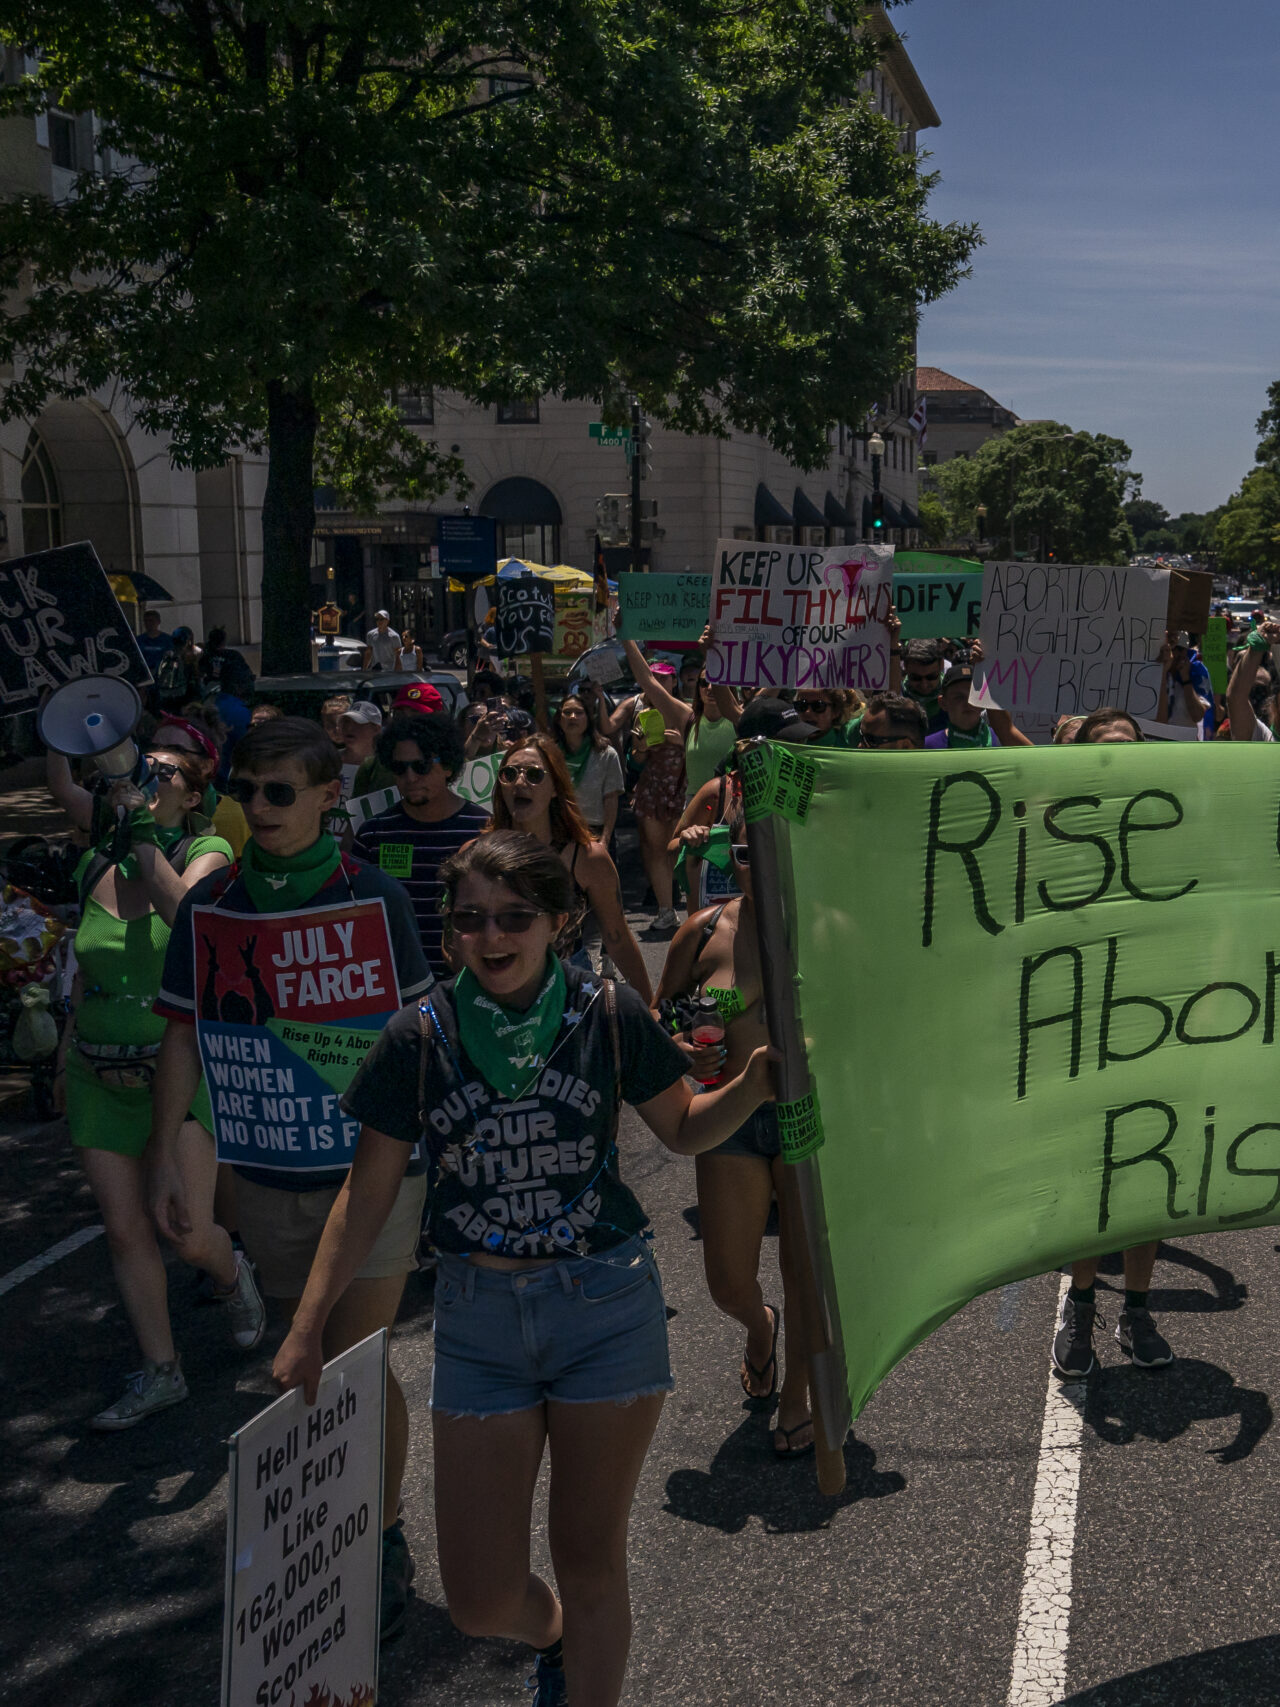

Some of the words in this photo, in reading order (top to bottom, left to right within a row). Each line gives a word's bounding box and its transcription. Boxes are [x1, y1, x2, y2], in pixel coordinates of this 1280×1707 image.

[600, 438, 620, 446] 1400
[677, 575, 712, 587] CREE
[720, 551, 782, 587] KEEP
[787, 553, 824, 586] UR
[626, 592, 650, 608] KEEP
[716, 588, 842, 626] FILTHY
[845, 582, 892, 632] LAWS
[986, 565, 1128, 613] ABORTION
[501, 626, 536, 655] US
[672, 616, 696, 629] FROM
[782, 626, 808, 647] OFF
[808, 624, 846, 645] OUR
[996, 613, 1105, 655] RIGHTS
[1106, 617, 1168, 662] ARE
[0, 627, 130, 703] LAWS
[705, 641, 797, 687] SILKY
[796, 643, 887, 689] DRAWERS
[978, 655, 1043, 705] MY
[1056, 660, 1161, 715] RIGHTS
[779, 753, 794, 783] HELL
[794, 760, 806, 788] ROE?
[773, 786, 787, 810] NO!
[797, 765, 815, 818] OVERTURN
[921, 770, 1198, 947] Rise
[272, 920, 355, 968] JULY
[275, 959, 386, 1009] FARCE
[204, 1032, 271, 1064] WHEN
[282, 1027, 310, 1044] Rise
[314, 1031, 331, 1048] Up
[334, 1035, 343, 1047] 4
[307, 1048, 349, 1068] Rights
[209, 1061, 296, 1094] WOMEN
[218, 1090, 257, 1120] ARE
[262, 1096, 313, 1123] NOT
[429, 1080, 490, 1135] OUR
[512, 1068, 600, 1117] DIES
[220, 1119, 249, 1146] NO
[257, 1124, 302, 1151] ONE
[309, 1124, 335, 1151] IS
[475, 1111, 557, 1146] OUR
[482, 1189, 561, 1226] OUR
[256, 1425, 298, 1491] Hell
[306, 1387, 356, 1449] Hath
[264, 1486, 292, 1532] No
[301, 1440, 348, 1498] Fury
[282, 1501, 328, 1560] Like
[236, 1502, 368, 1646] 162,000,000
[262, 1576, 340, 1667] Women
